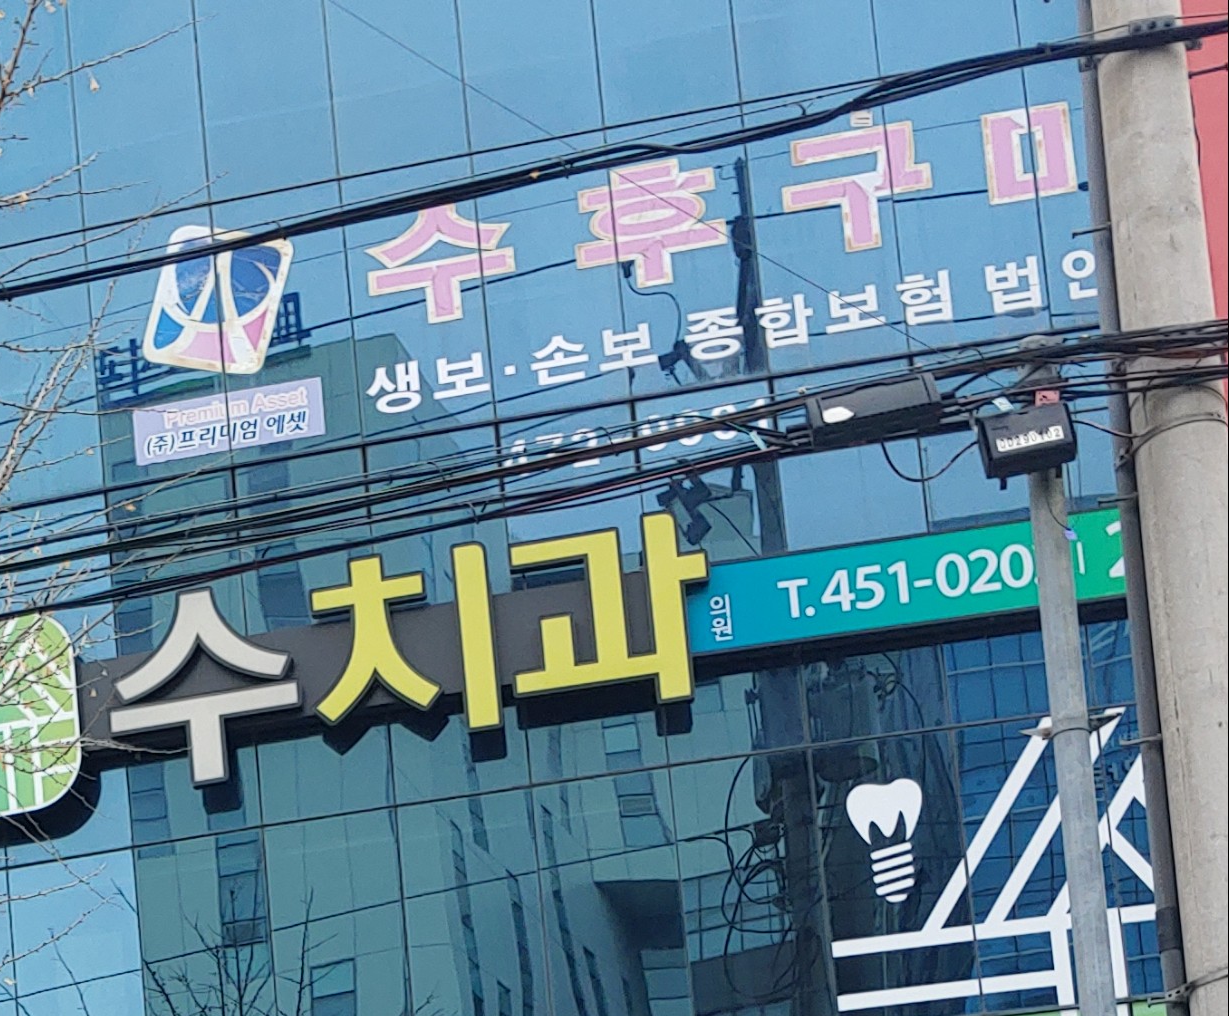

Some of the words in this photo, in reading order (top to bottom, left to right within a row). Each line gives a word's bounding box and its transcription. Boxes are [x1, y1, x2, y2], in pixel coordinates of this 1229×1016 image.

[685, 268, 954, 361] 종합보험
[146, 418, 258, 457] (주)프리미엄
[266, 410, 307, 436] 에셋
[164, 398, 248, 430] Premium
[251, 386, 307, 412] Asset
[777, 542, 1040, 619] T.451-020
[108, 510, 709, 788] 수치과
[710, 594, 733, 642] 의원
